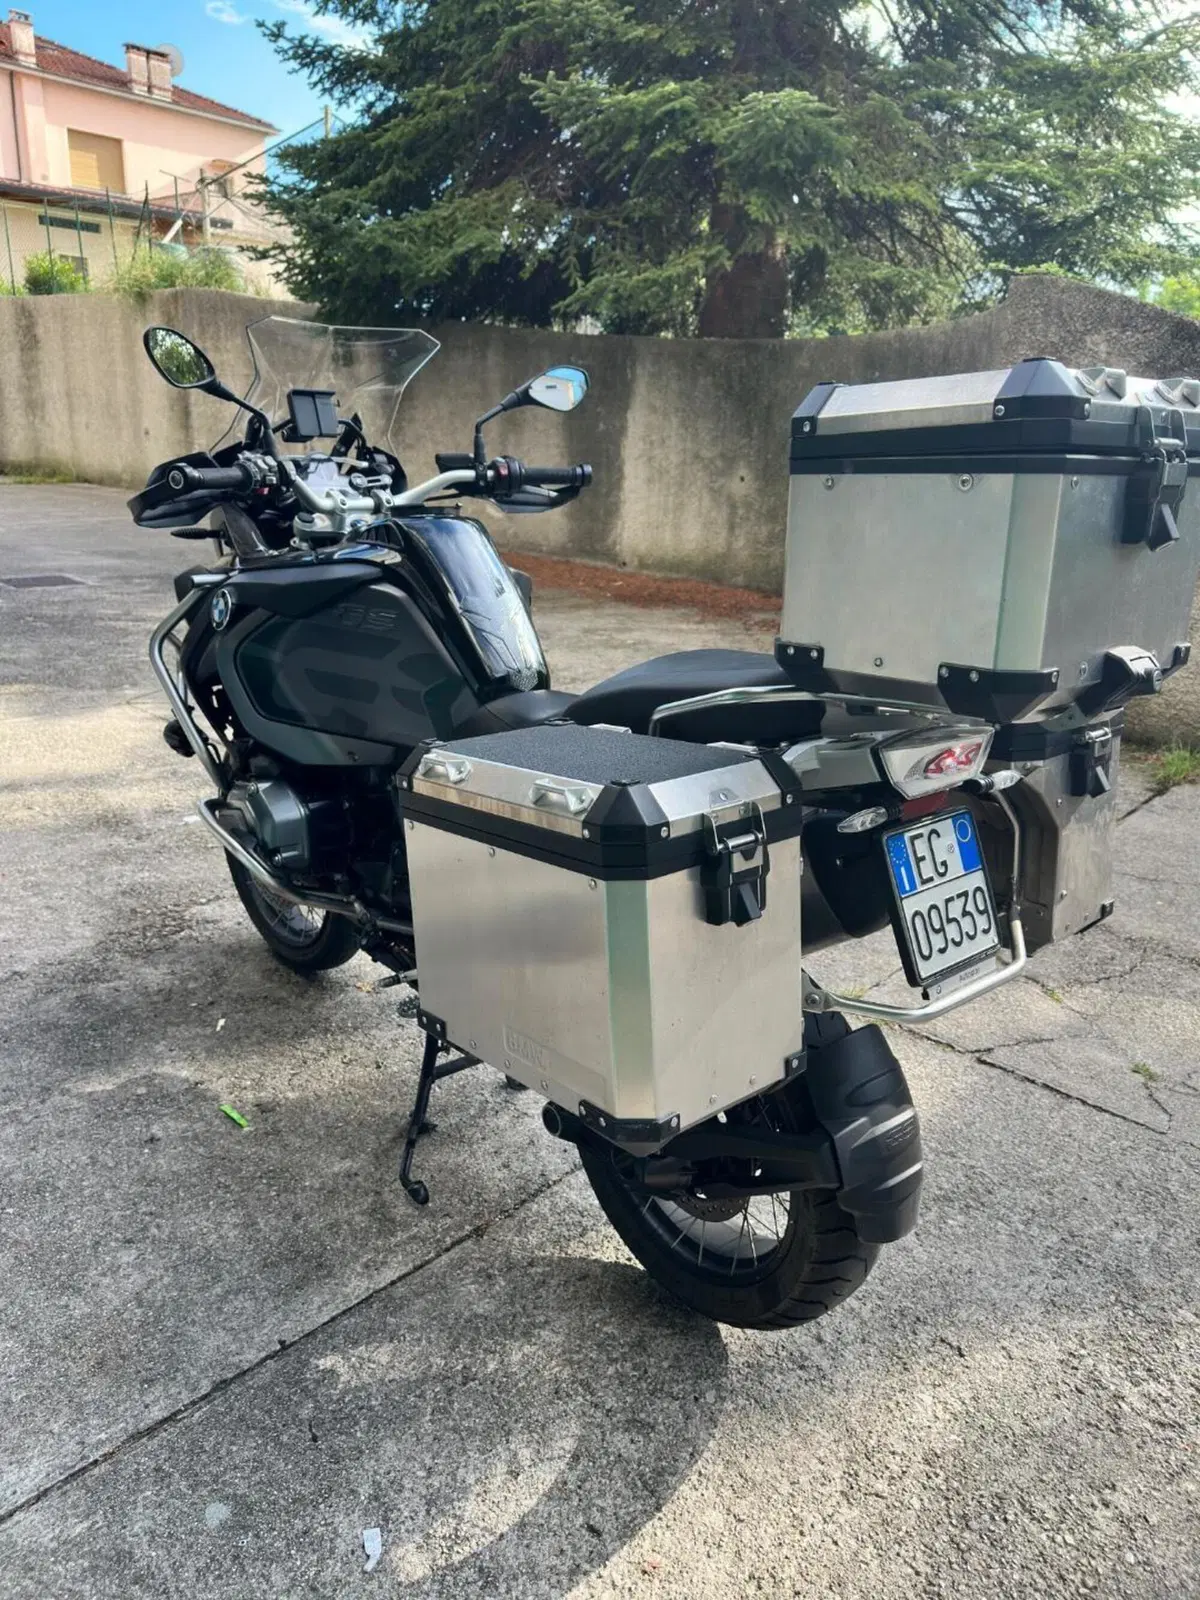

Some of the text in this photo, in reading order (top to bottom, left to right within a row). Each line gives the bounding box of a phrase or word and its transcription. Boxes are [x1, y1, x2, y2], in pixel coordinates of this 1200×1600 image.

[901, 866, 910, 891] I
[909, 828, 949, 885] EG
[911, 886, 992, 961] 09539
